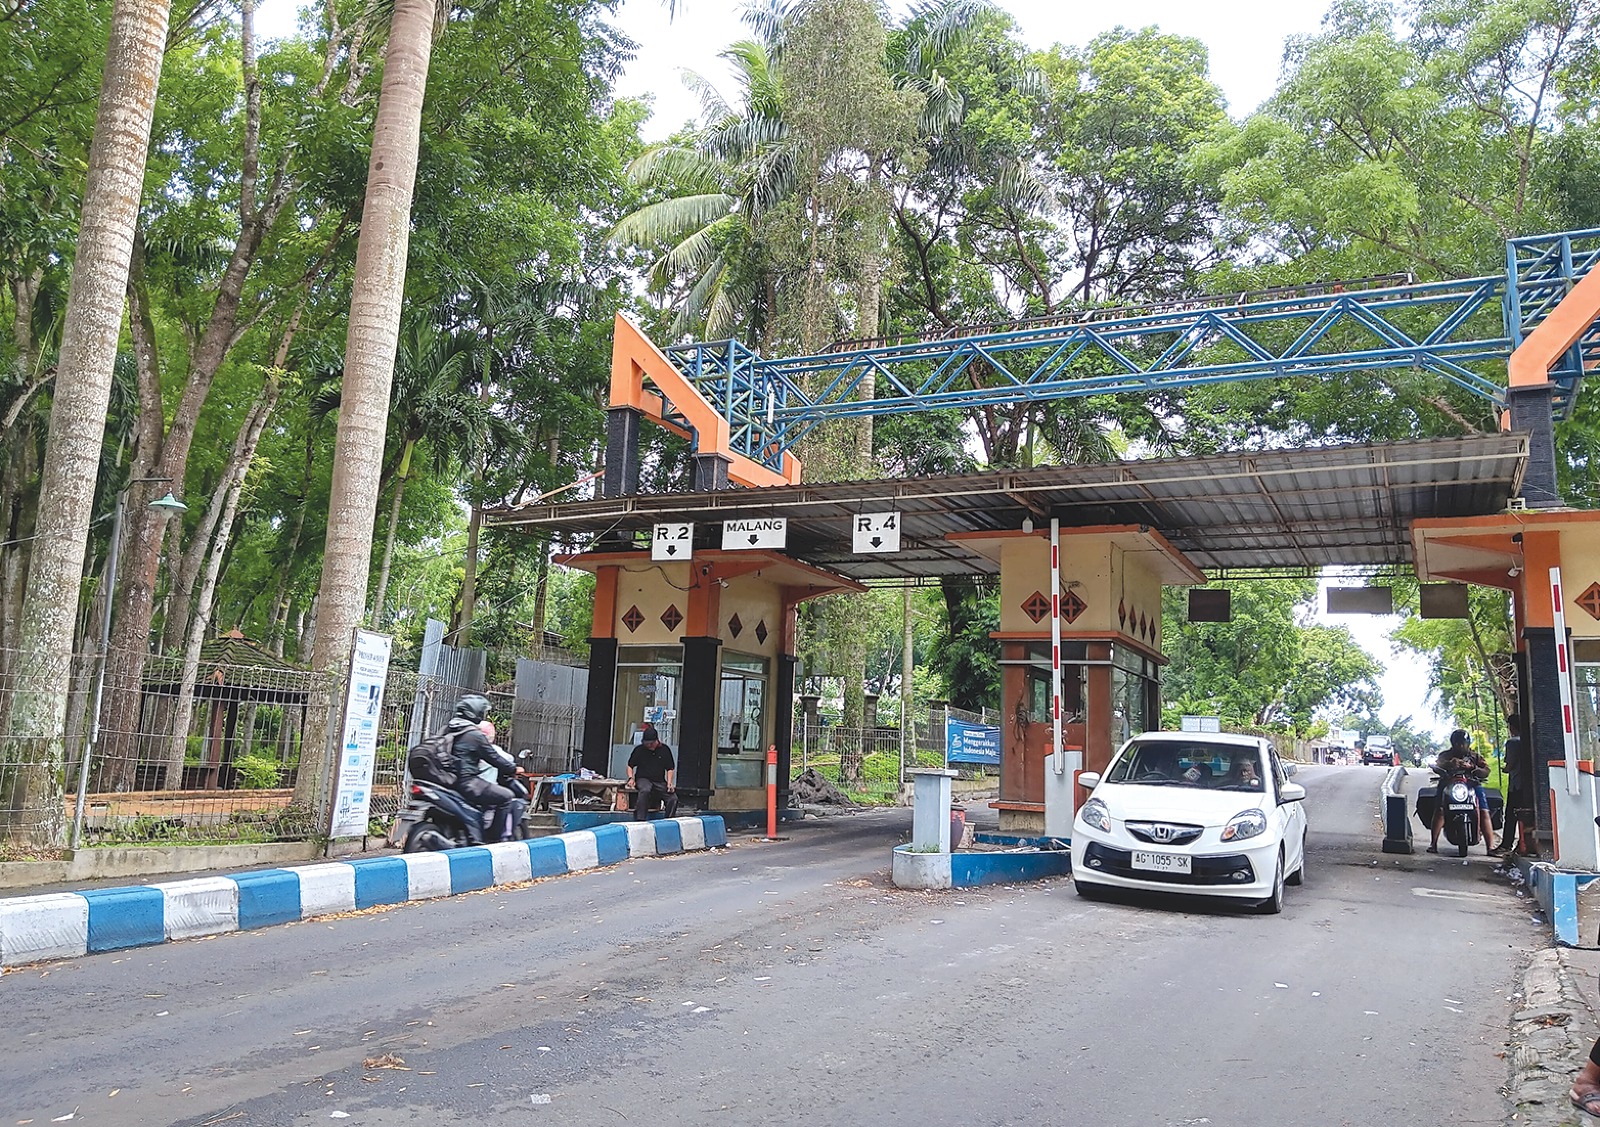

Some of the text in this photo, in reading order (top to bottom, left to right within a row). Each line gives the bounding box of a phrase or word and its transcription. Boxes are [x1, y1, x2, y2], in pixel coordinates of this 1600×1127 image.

[726, 520, 783, 532] MALANG
[857, 515, 896, 532] R.4
[656, 526, 690, 540] R.2
[1135, 853, 1146, 863] AG
[1151, 854, 1171, 866] 1055
[1177, 857, 1188, 868] SK
